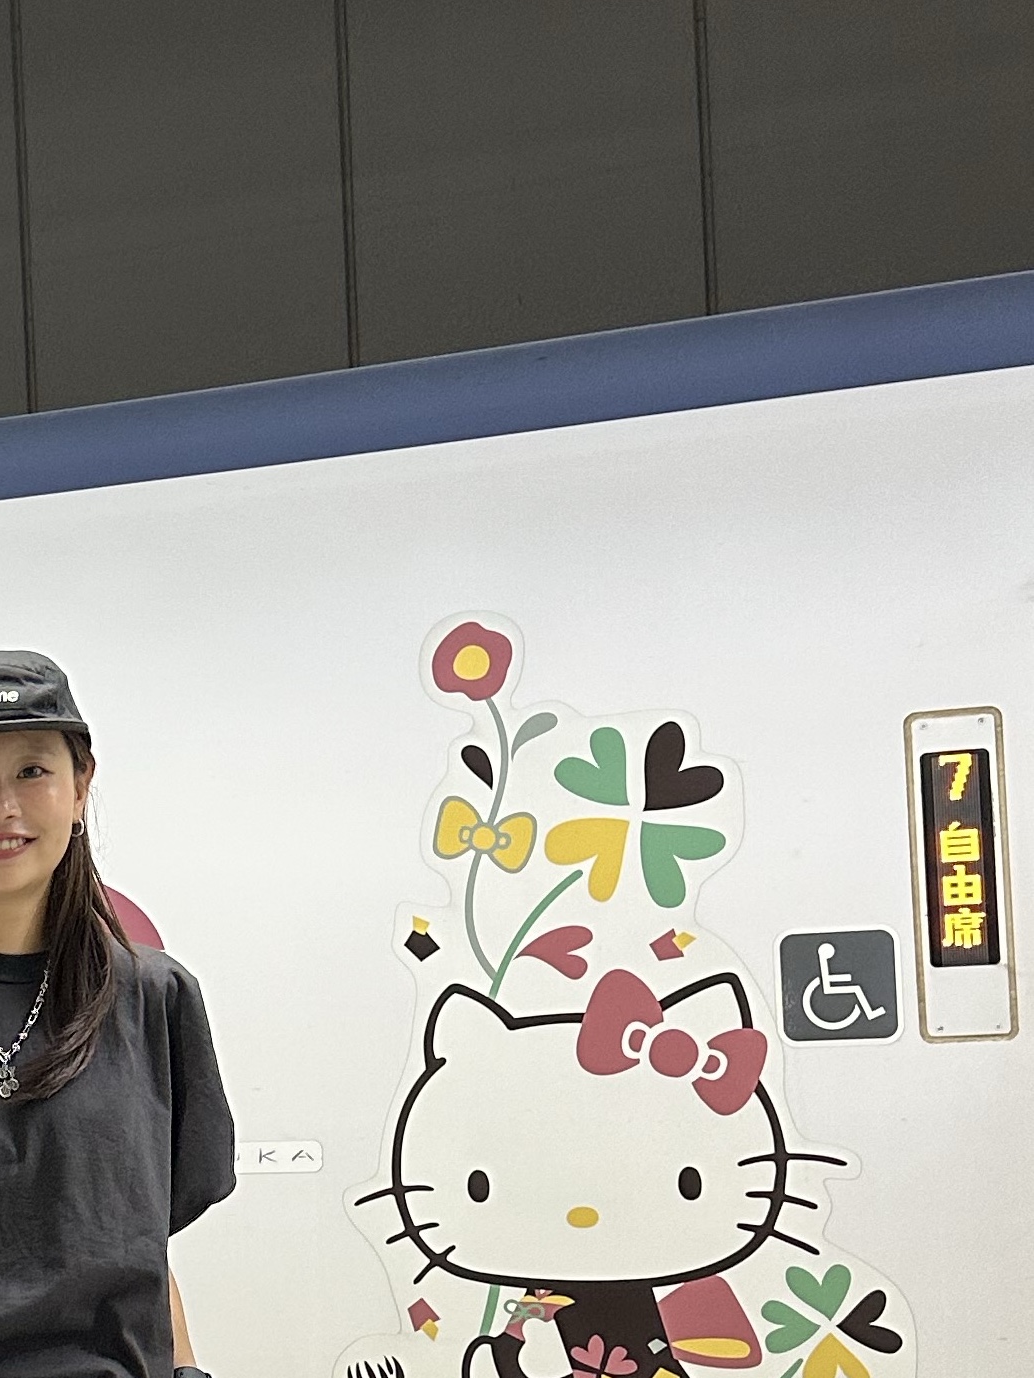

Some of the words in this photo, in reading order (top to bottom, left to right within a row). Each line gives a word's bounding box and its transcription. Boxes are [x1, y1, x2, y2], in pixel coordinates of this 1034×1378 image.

[938, 753, 972, 801] 7
[940, 821, 986, 949] 自由席
[236, 1148, 315, 1164] KA
